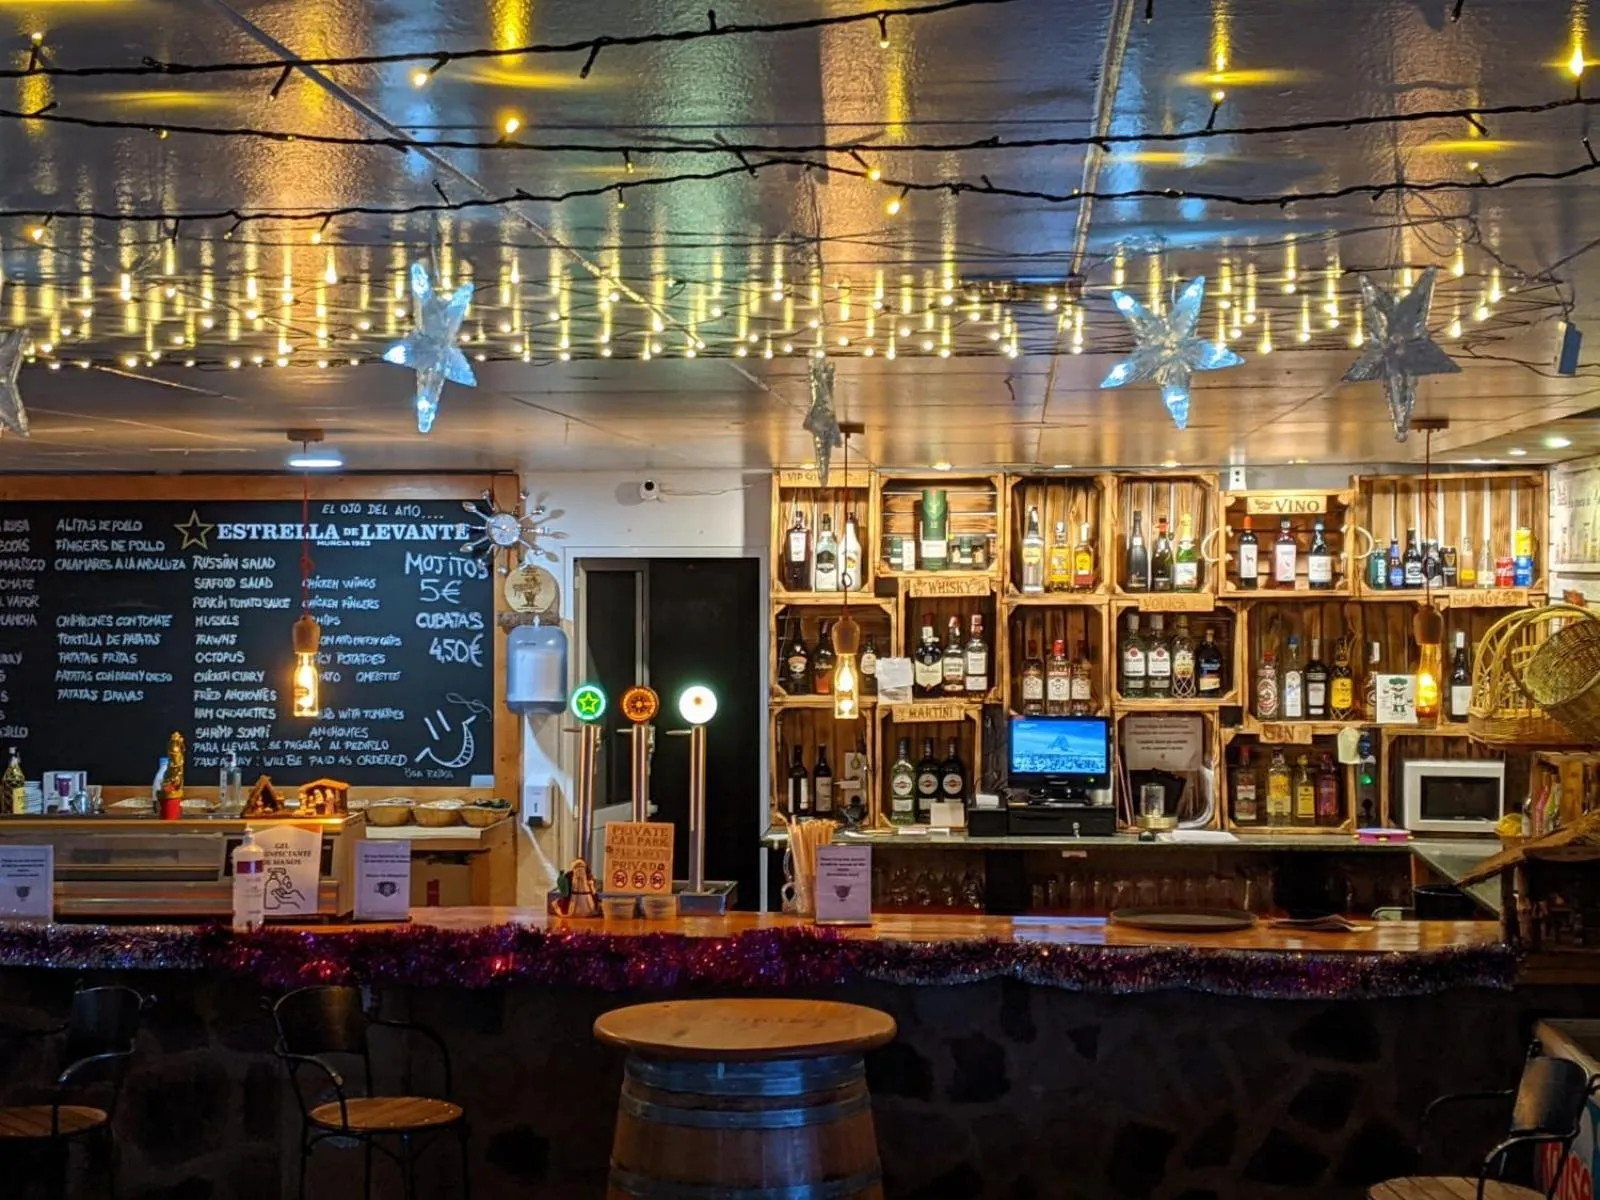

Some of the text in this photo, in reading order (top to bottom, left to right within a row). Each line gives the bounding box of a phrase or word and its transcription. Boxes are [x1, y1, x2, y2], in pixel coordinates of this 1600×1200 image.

[321, 504, 336, 514] EL
[340, 503, 362, 514] OJO
[367, 504, 388, 516] DEL
[1276, 498, 1320, 513] VINO
[56, 517, 97, 532] ALITAS
[112, 520, 143, 532] POLLO
[217, 523, 470, 541] ESTRELLA DE LEVANTE
[55, 538, 166, 552] FINGERS DE POLLO
[192, 553, 276, 570] RUSSIAN SALAD
[404, 551, 489, 580] MOJITOS
[194, 575, 274, 590] SEAFOOD SALAD
[342, 575, 377, 589] WINGS
[928, 580, 973, 595] WHISKY
[419, 578, 463, 605] 5€
[7, 595, 40, 608] VAPOR
[228, 597, 262, 609] TOMATO
[262, 597, 292, 609] SAUCE
[415, 611, 485, 631] CUBATAS
[106, 634, 121, 646] DE
[194, 650, 246, 664] OCTOPUS
[337, 652, 386, 666] POTATOES
[231, 670, 265, 683] CURRY
[57, 688, 99, 702] PATATAS
[193, 687, 222, 701] FRIED
[908, 705, 953, 719] MARTINI
[195, 724, 234, 739] SHRIMP
[1264, 725, 1296, 741] GIN
[193, 742, 219, 753] PARA
[329, 740, 341, 751] AL
[263, 756, 285, 767] WILL
[285, 754, 303, 767] BE
[338, 755, 352, 767] AS
[356, 753, 408, 768] ORDERED
[612, 825, 668, 837] PRIVATE
[611, 860, 665, 871] PRIVADO
